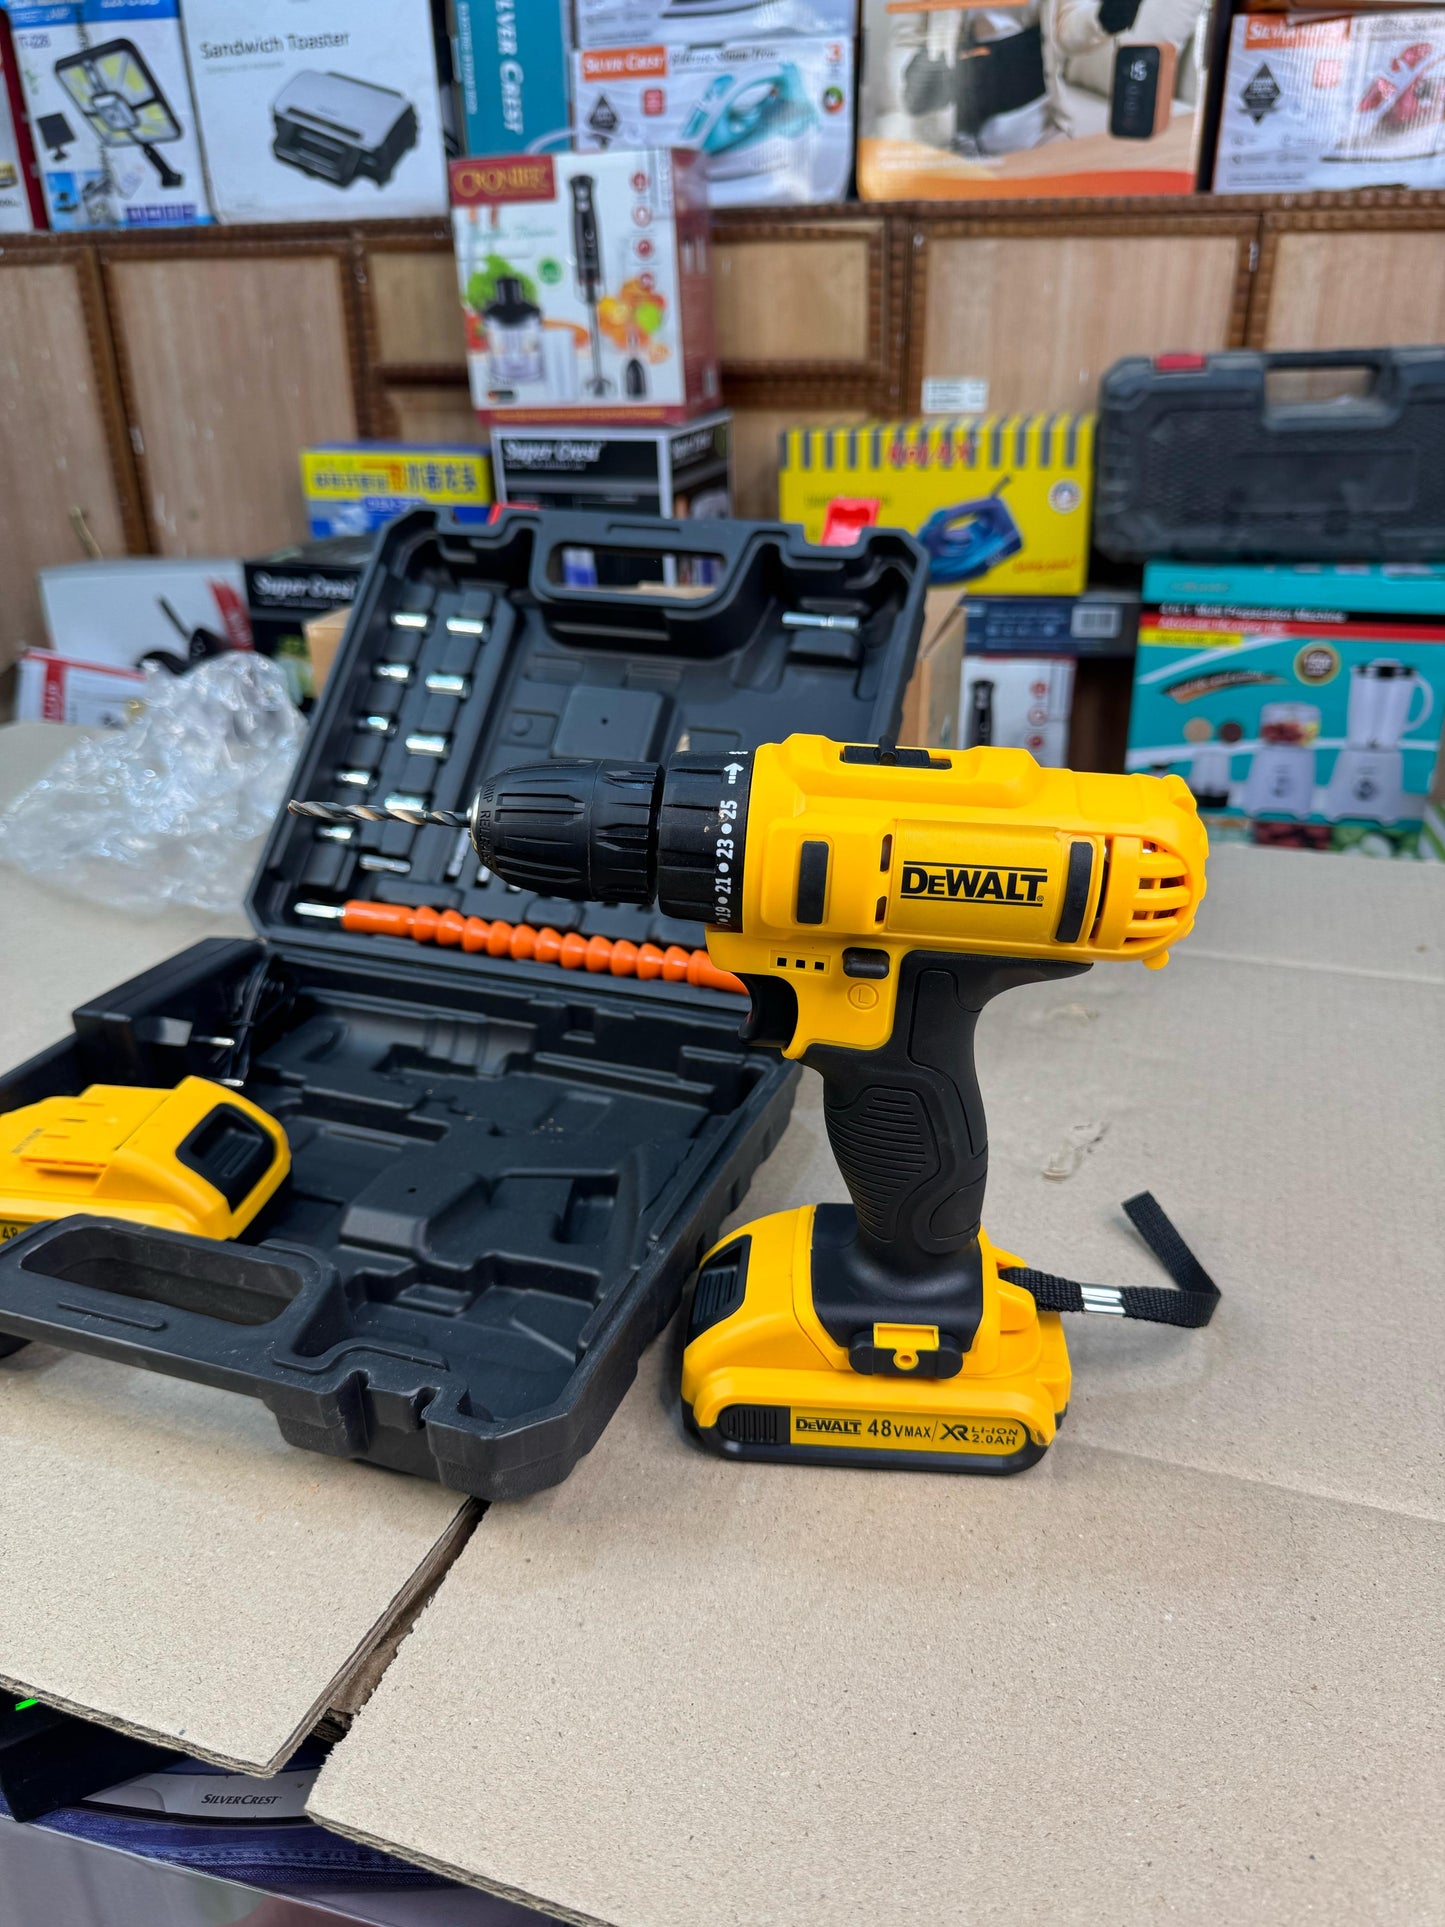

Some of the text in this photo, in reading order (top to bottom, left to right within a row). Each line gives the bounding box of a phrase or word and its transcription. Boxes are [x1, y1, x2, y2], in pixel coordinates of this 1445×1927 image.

[201, 32, 350, 59] Sandwich Toaster
[500, 60, 524, 135] CREST
[715, 800, 738, 919] 19 21 23 25
[901, 867, 1048, 902] DEWALT
[796, 1418, 862, 1433] DEWALT
[939, 1423, 969, 1441] XR
[971, 1426, 1018, 1436] LI-ION
[972, 1433, 1016, 1446] 2.0AH
[201, 1793, 280, 1805] SILVERCREST
